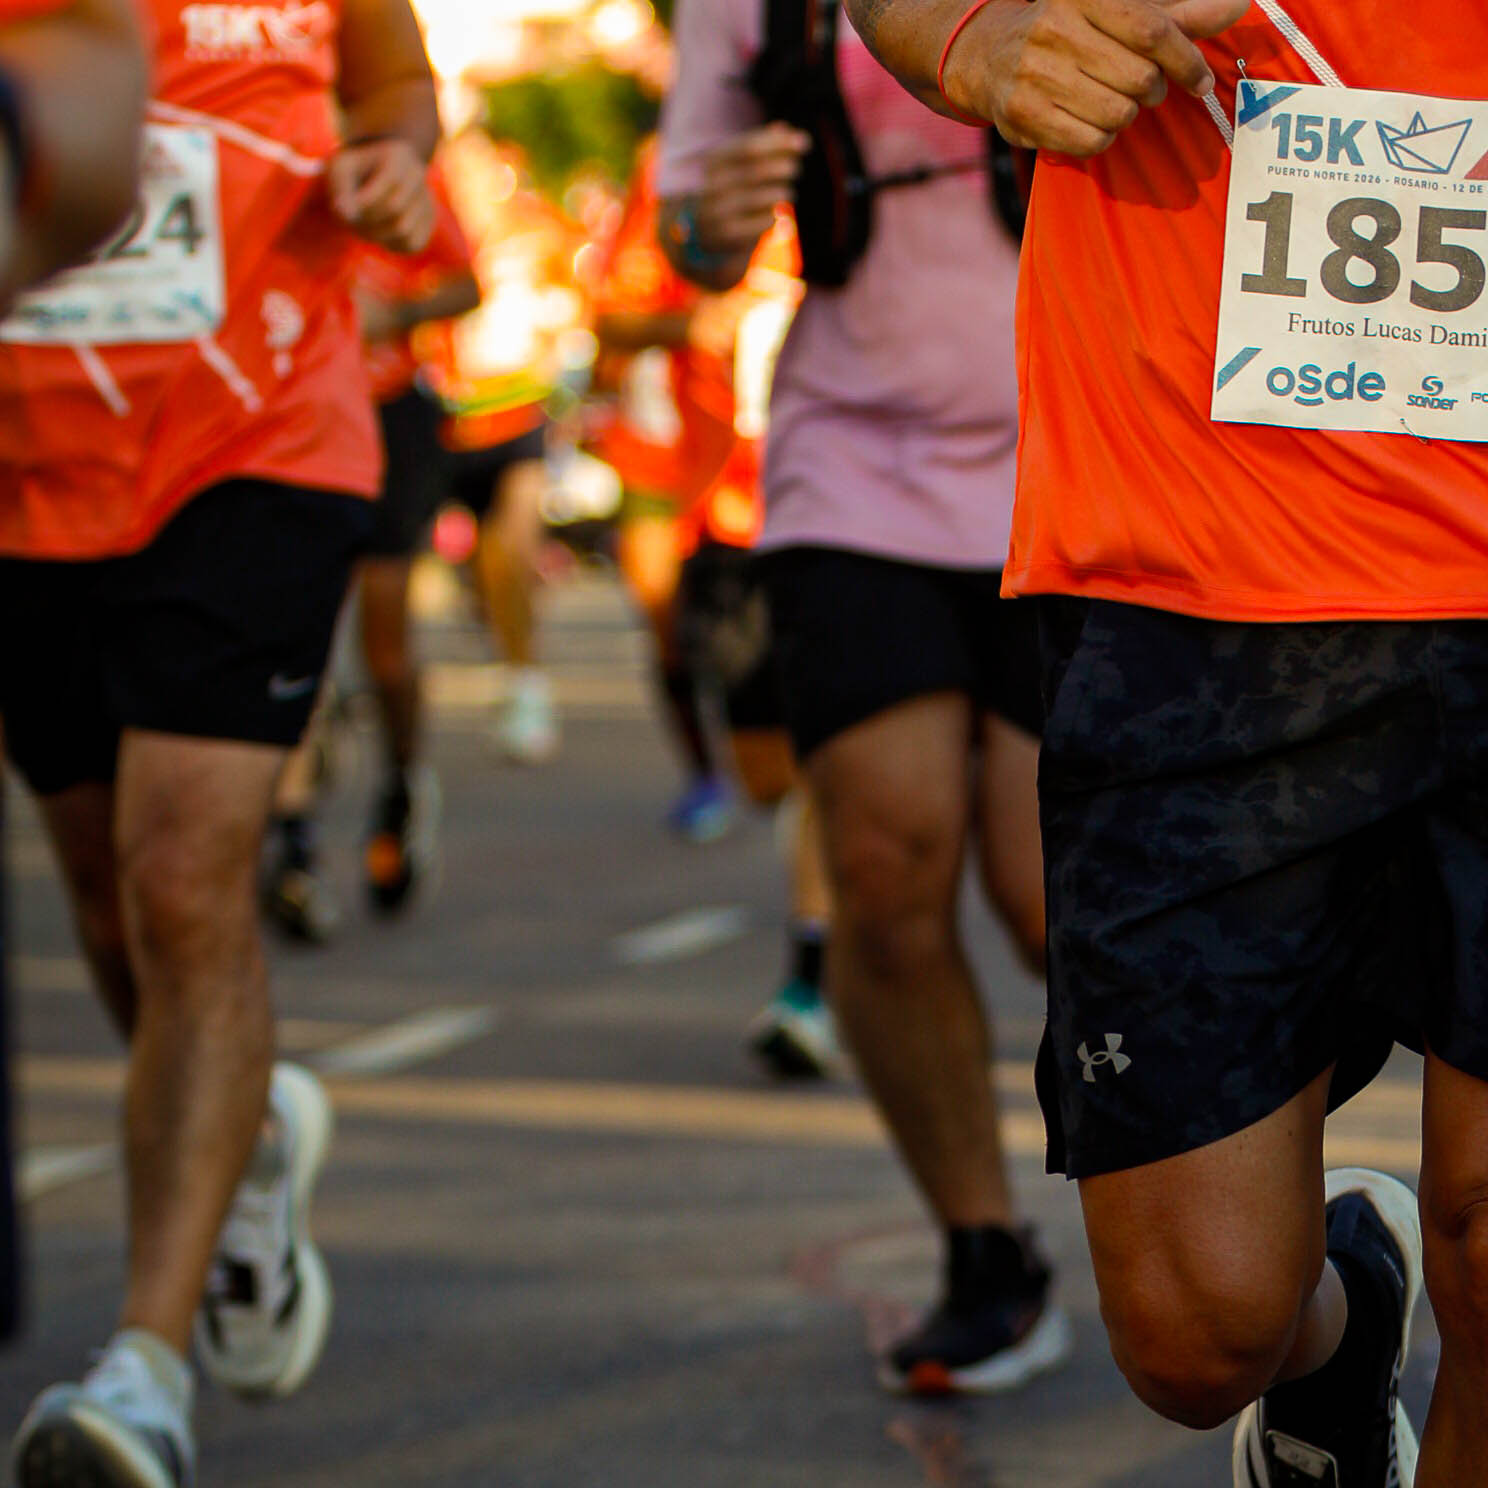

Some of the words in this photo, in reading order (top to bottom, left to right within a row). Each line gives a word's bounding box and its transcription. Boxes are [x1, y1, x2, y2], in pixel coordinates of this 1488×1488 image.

[1271, 112, 1367, 166] 15K
[1267, 165, 1310, 179] PUERTO
[1313, 169, 1350, 182] NORTE
[1353, 173, 1382, 185] 2026
[1393, 176, 1439, 192] ROSARIO
[1452, 183, 1465, 193] 12
[1469, 183, 1483, 194] DE
[1287, 312, 1355, 337] Frutos
[1362, 317, 1422, 343] Lucas
[1266, 362, 1386, 404] osde
